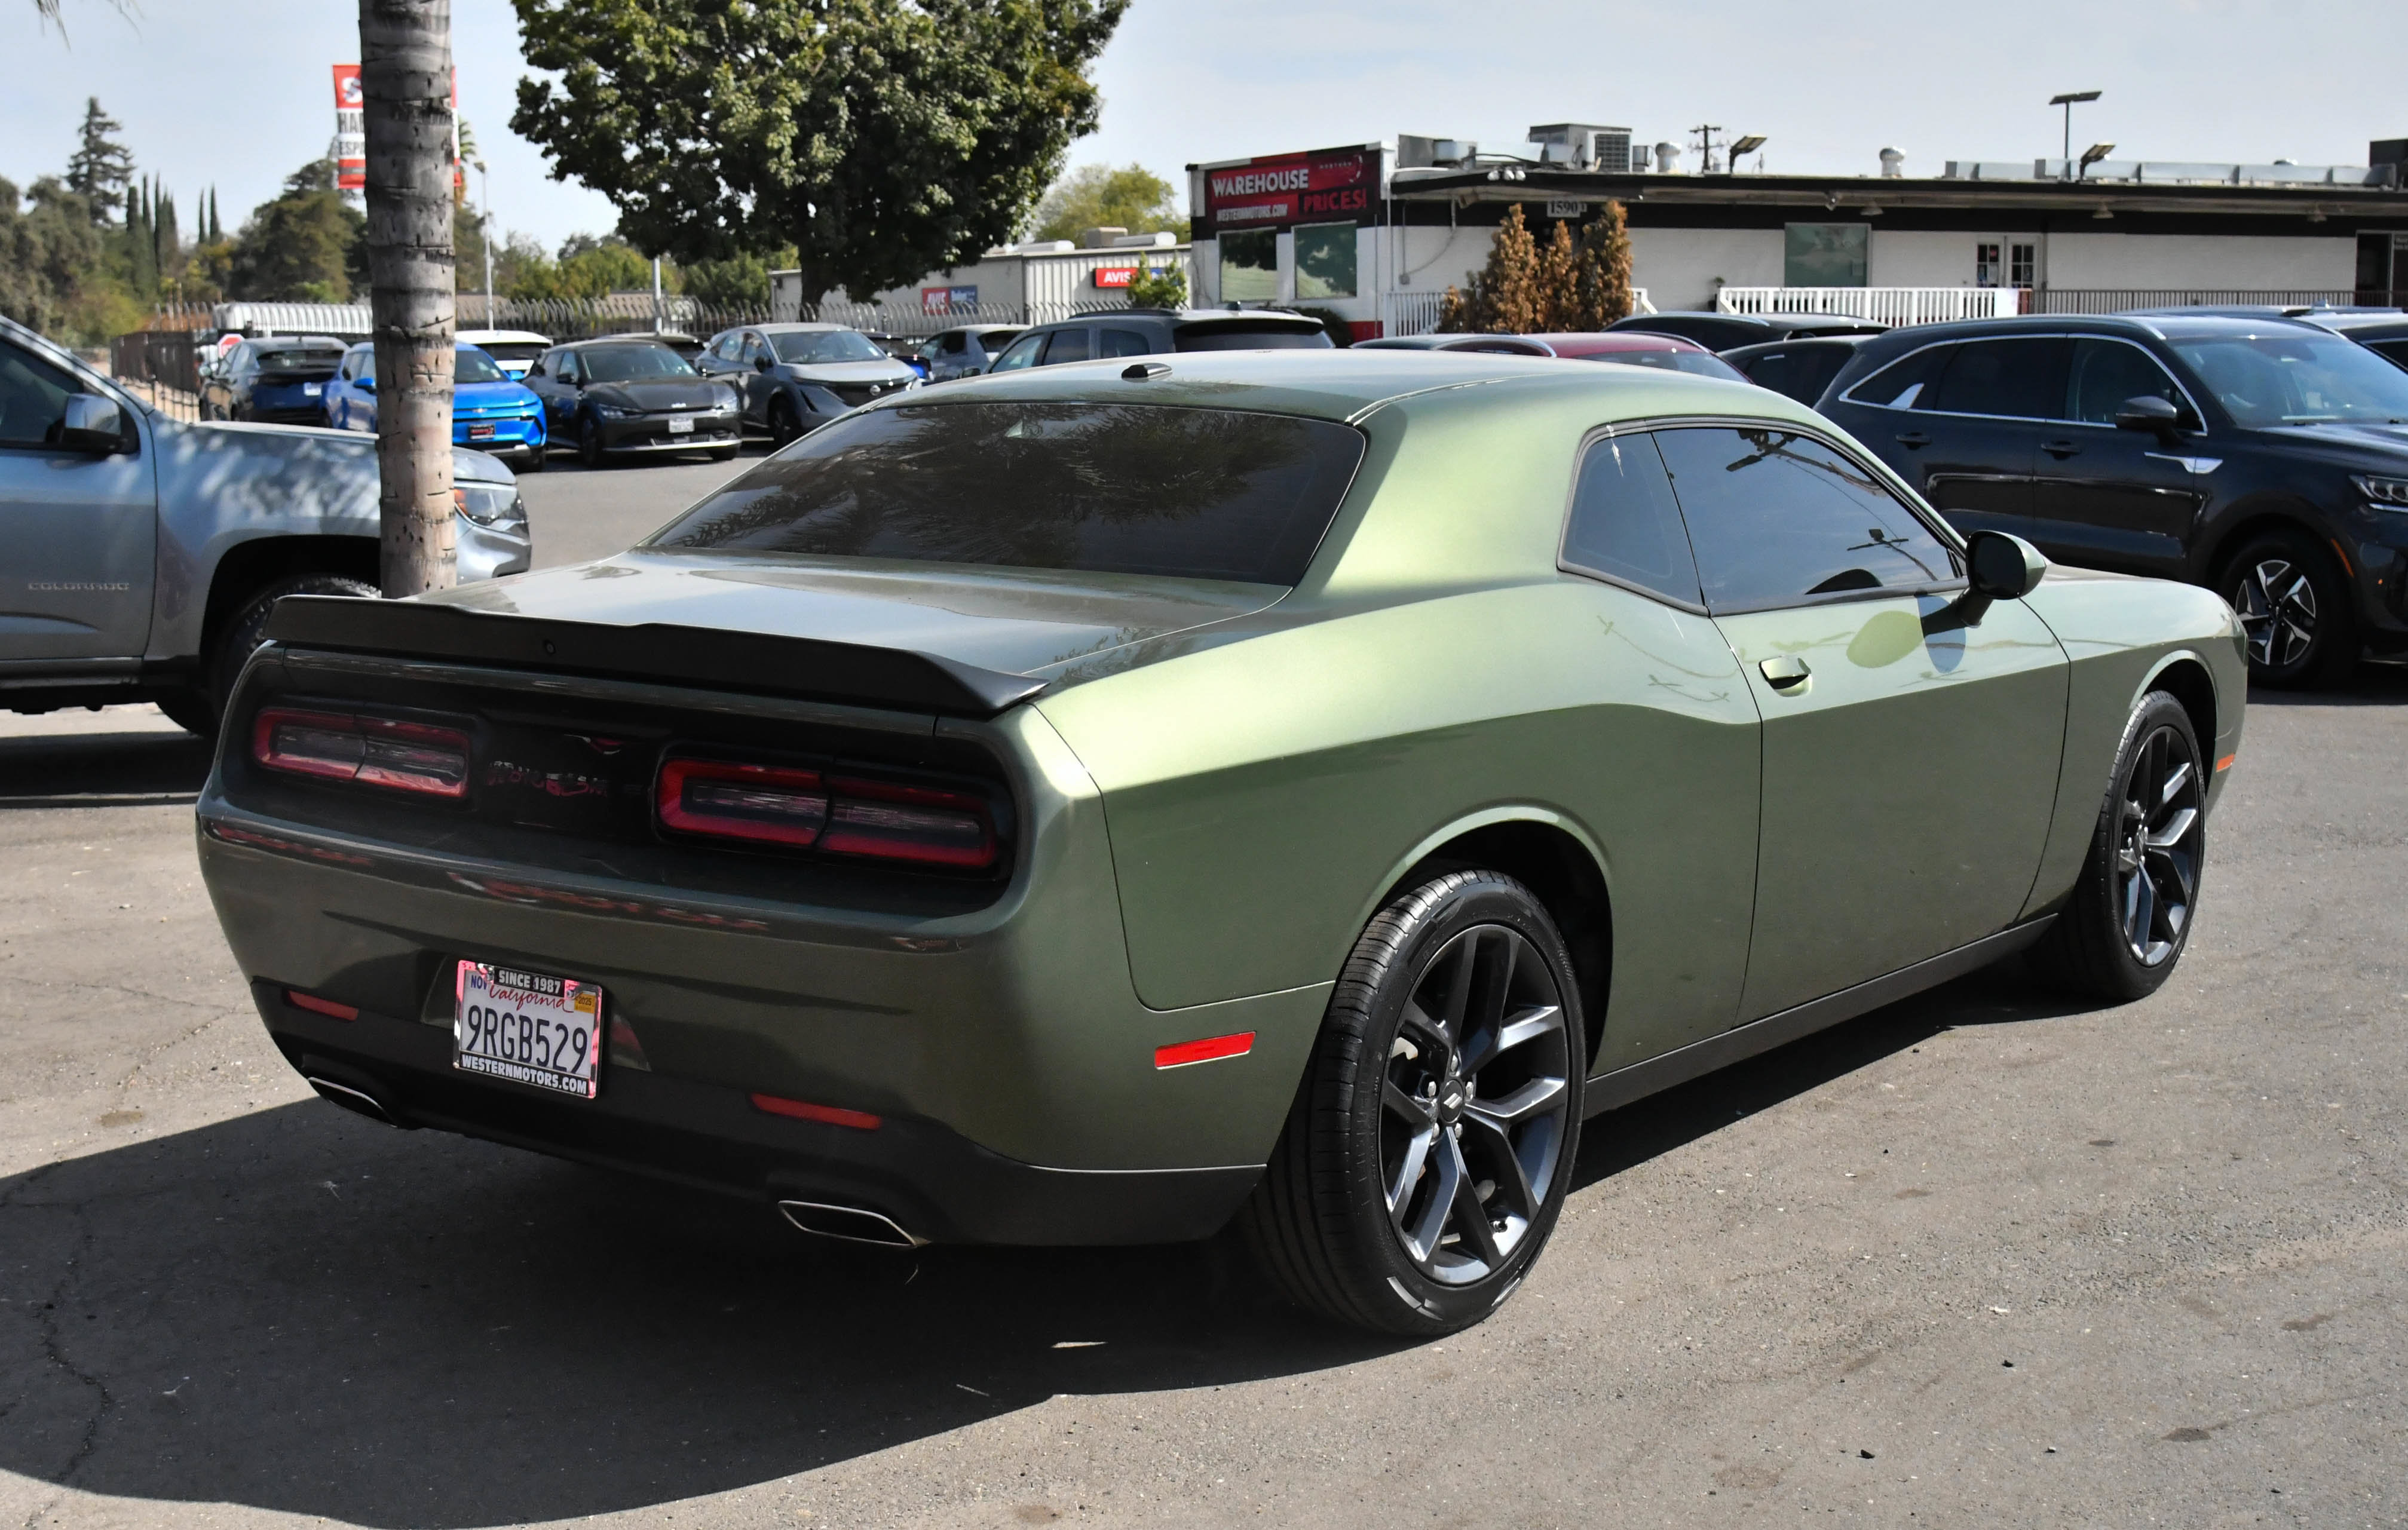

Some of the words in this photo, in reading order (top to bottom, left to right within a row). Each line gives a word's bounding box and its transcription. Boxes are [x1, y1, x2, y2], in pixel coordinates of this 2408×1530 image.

[1212, 168, 1309, 198] WAREHOUSE
[1303, 188, 1367, 213] PRICES!
[1550, 200, 1578, 214] 1590
[1104, 271, 1131, 283] AVIS
[498, 970, 531, 988] SINCE
[534, 977, 561, 994] 1987
[578, 996, 592, 1005] 2025
[466, 1005, 588, 1074] 9RGB529
[462, 1054, 587, 1094] WESTERNMOTORS.COM
